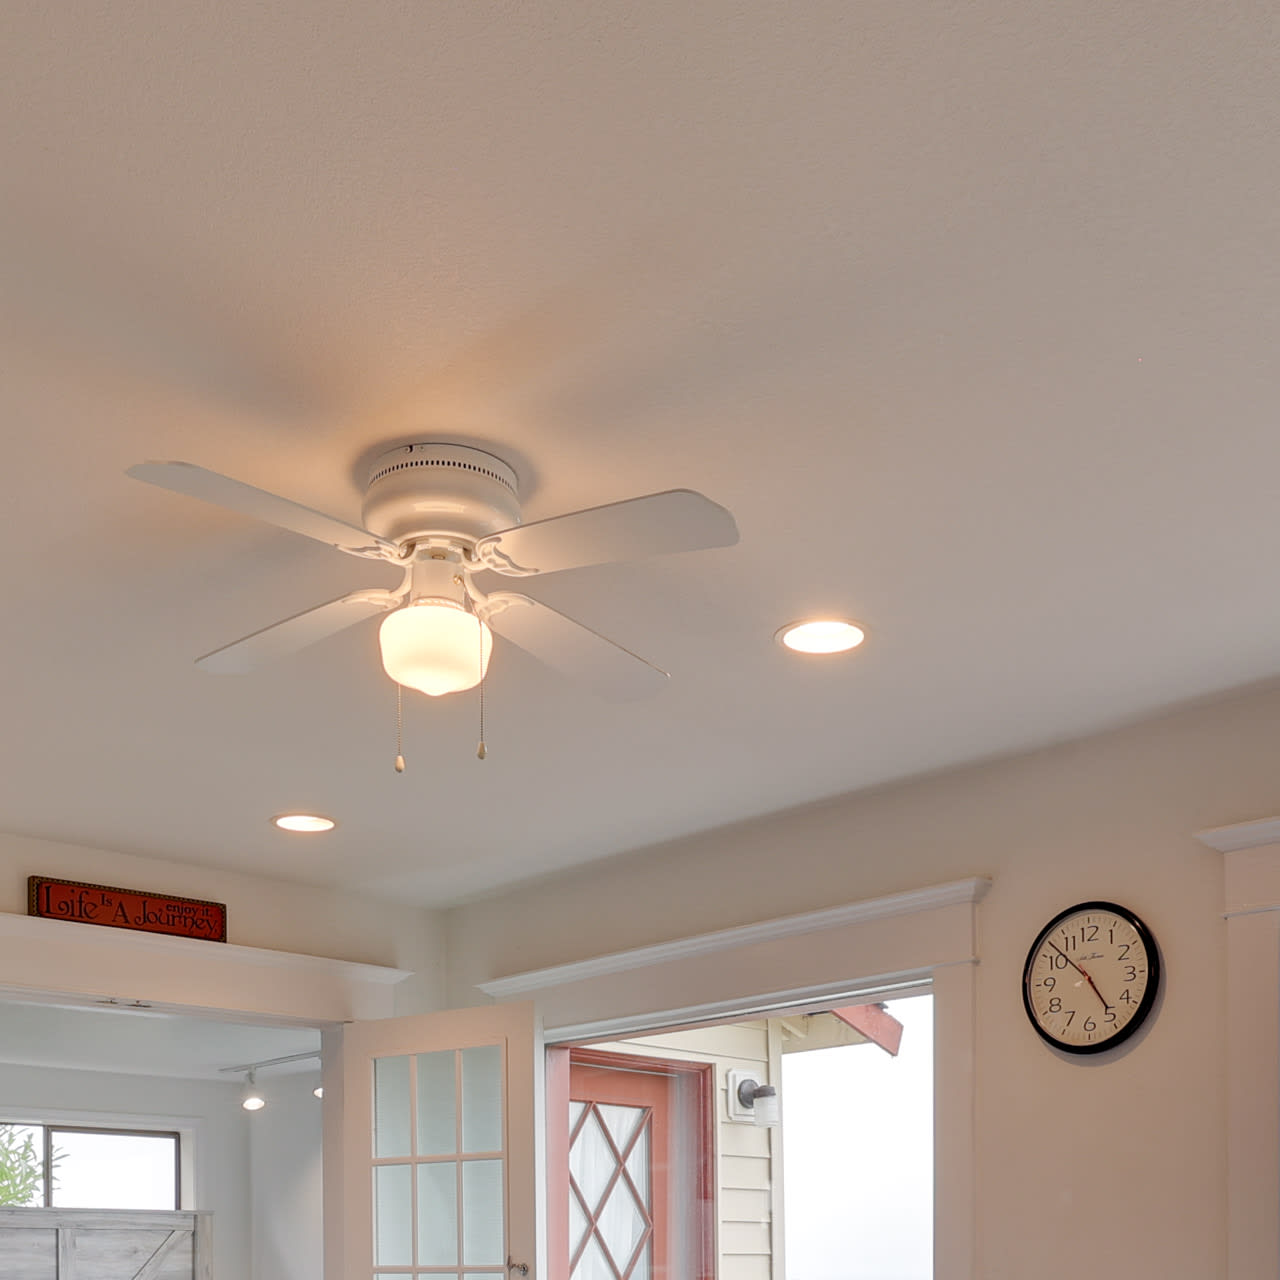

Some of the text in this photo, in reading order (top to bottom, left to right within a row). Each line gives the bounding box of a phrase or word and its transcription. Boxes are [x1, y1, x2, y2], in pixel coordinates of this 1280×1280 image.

[44, 885, 99, 919] Life
[101, 893, 113, 907] Is
[111, 901, 130, 924] A
[166, 902, 198, 917] enjoy
[1080, 925, 1099, 943] 12
[1109, 929, 1114, 945] 1
[1064, 935, 1076, 952] 11
[1118, 944, 1130, 961] 2
[1049, 953, 1069, 971] 10
[1124, 966, 1137, 982] 3
[1043, 977, 1056, 993] 9
[1048, 997, 1062, 1013] 8
[1119, 989, 1132, 1005] 4
[1065, 1010, 1076, 1027] 7
[1104, 1006, 1116, 1023] 5
[1083, 1016, 1096, 1032] 6
